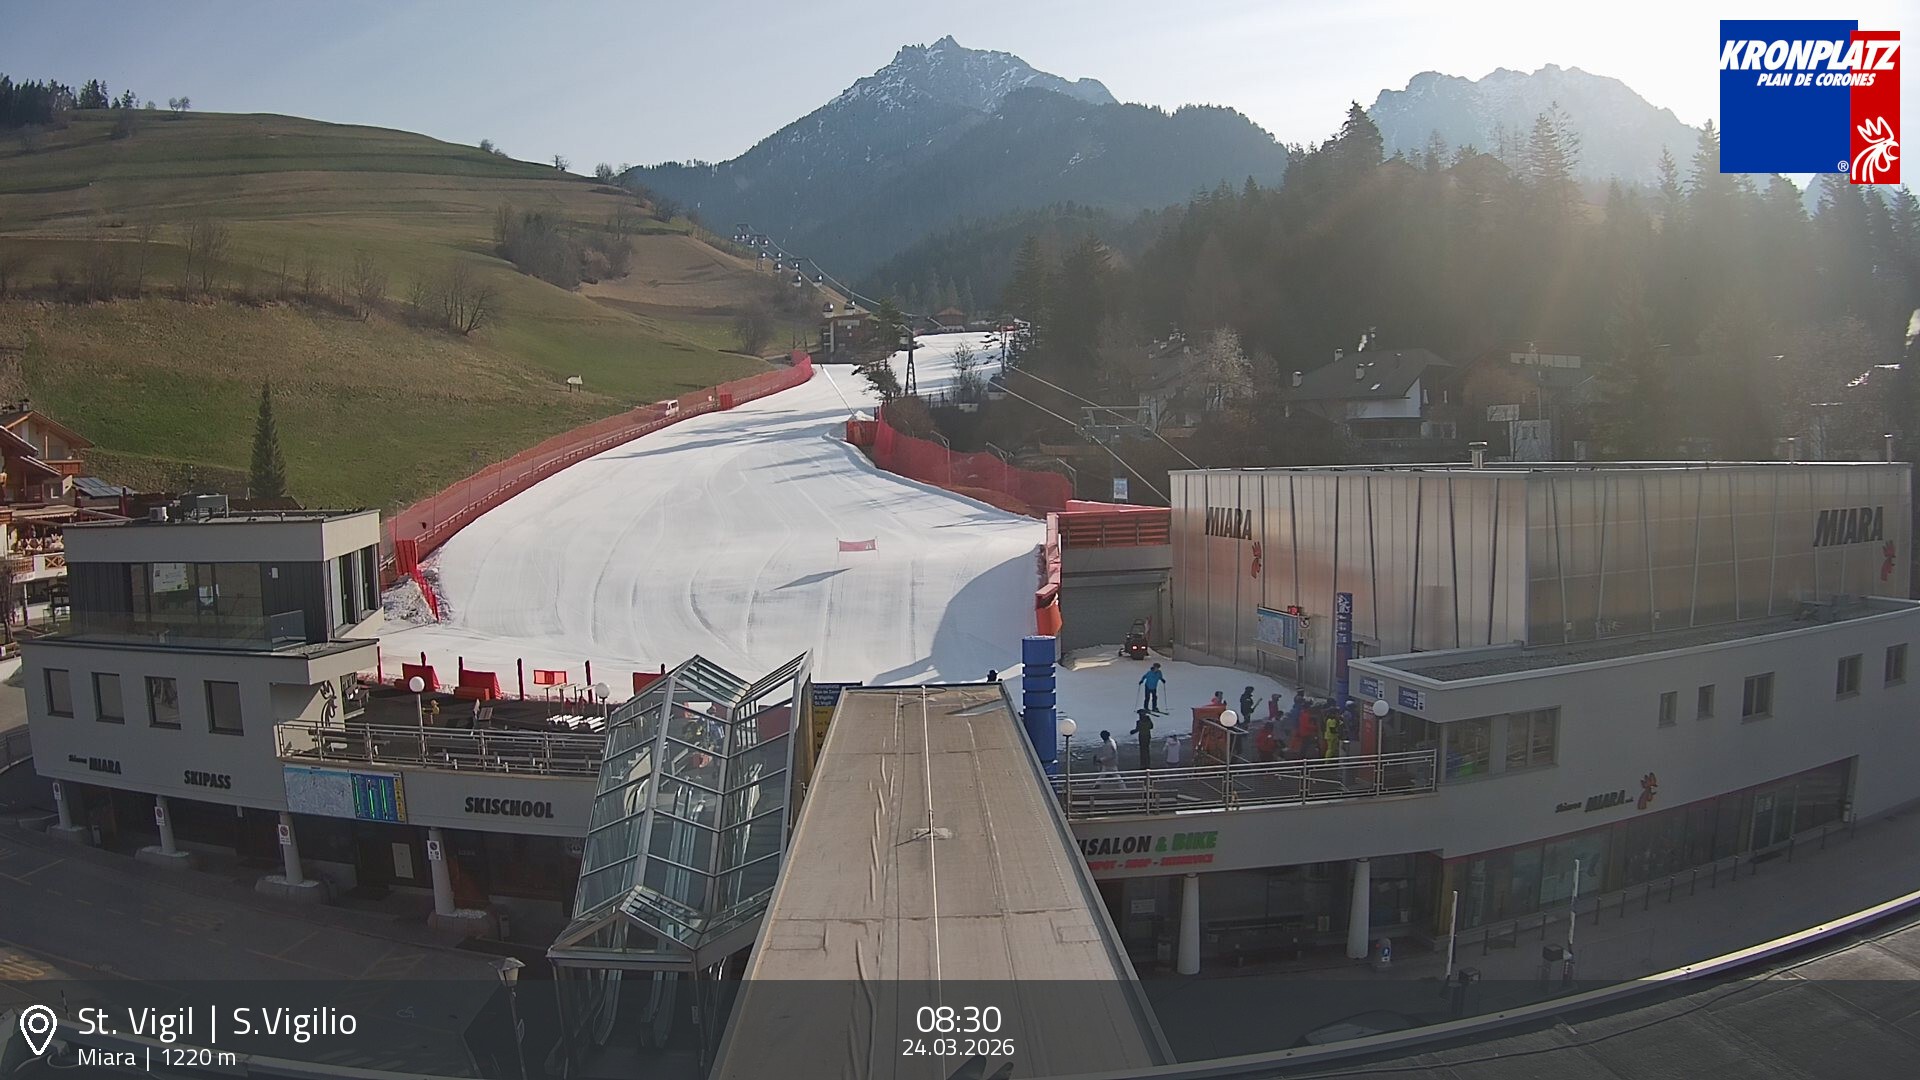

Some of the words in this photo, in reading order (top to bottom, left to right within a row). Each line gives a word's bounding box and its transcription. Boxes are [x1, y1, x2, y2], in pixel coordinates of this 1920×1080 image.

[1205, 507, 1252, 540] MIARA
[1813, 506, 1883, 547] MIARA
[89, 757, 122, 775] MIARA
[184, 770, 231, 790] SKIPASS
[465, 797, 554, 818] SKISCHOOL
[1584, 790, 1625, 812] MIARA
[1155, 836, 1168, 852] &
[1172, 831, 1218, 850] BIKE
